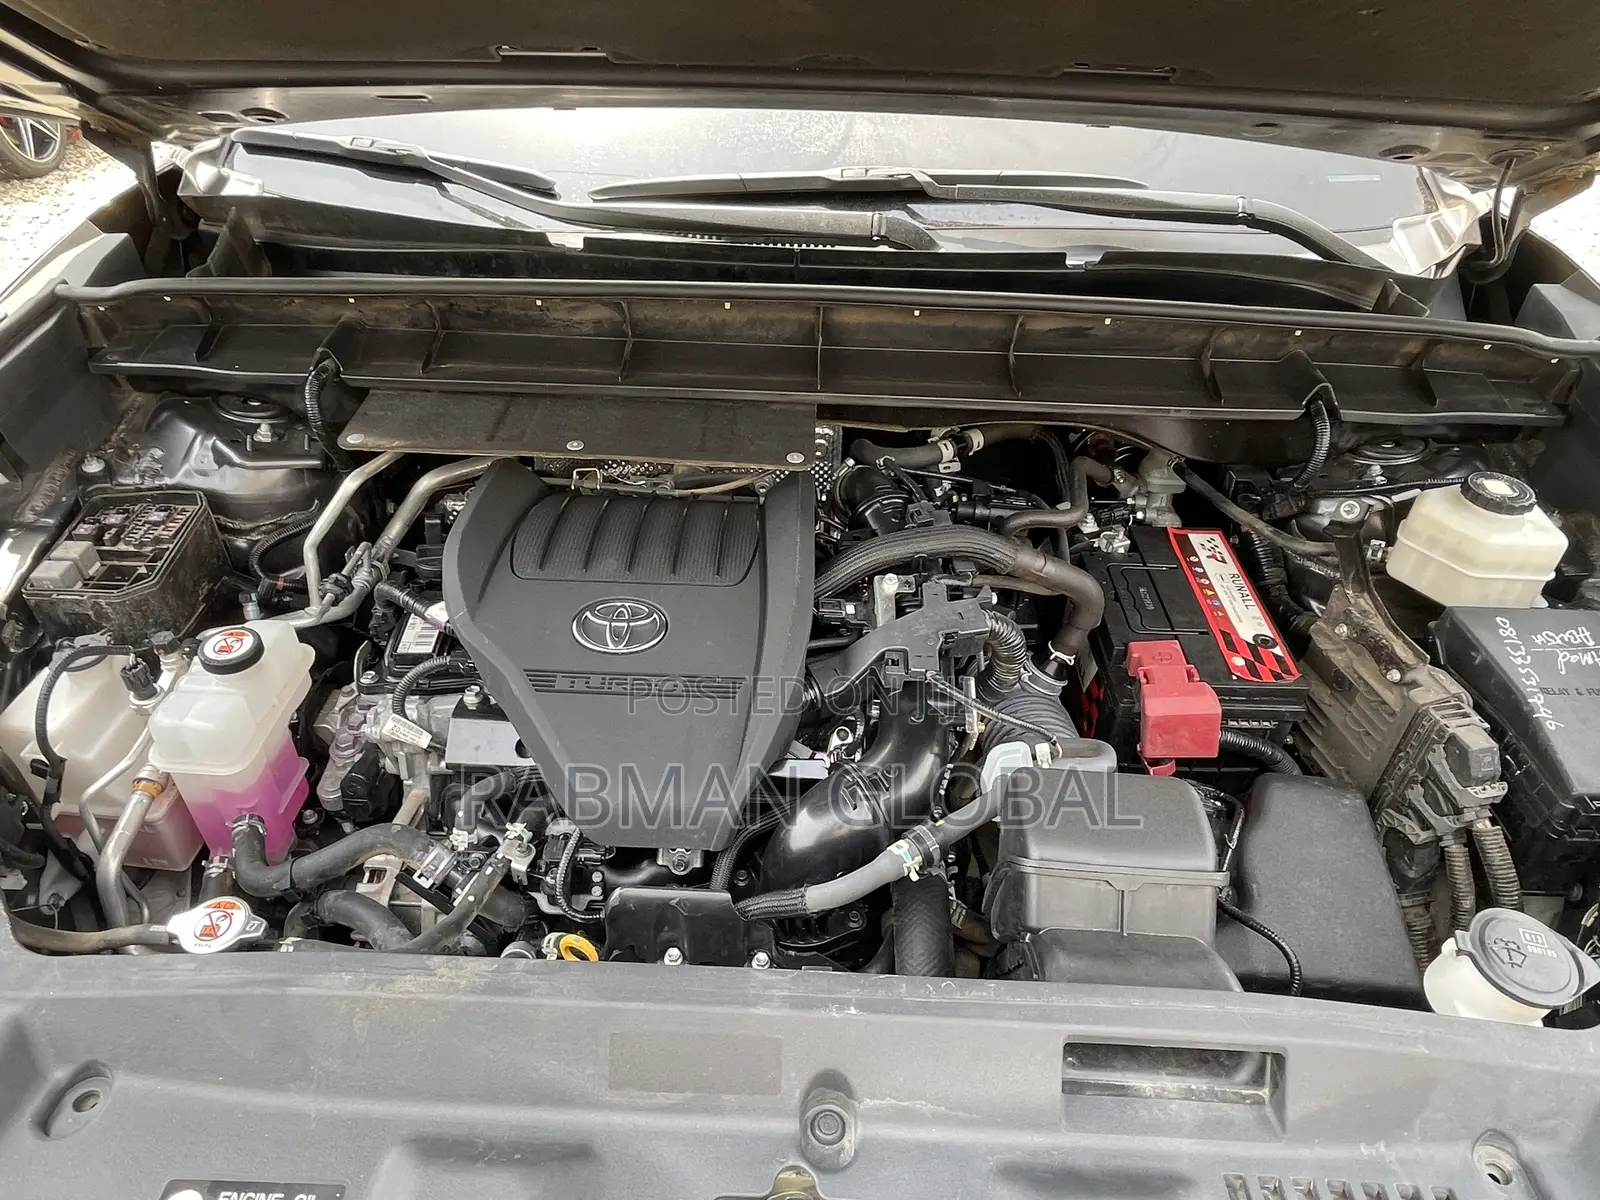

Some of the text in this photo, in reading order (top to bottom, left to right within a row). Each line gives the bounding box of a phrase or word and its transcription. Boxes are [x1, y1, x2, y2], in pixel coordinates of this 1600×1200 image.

[1228, 572, 1257, 611] RUNALL
[560, 674, 680, 693] TURBO
[1539, 686, 1571, 696] RELAY
